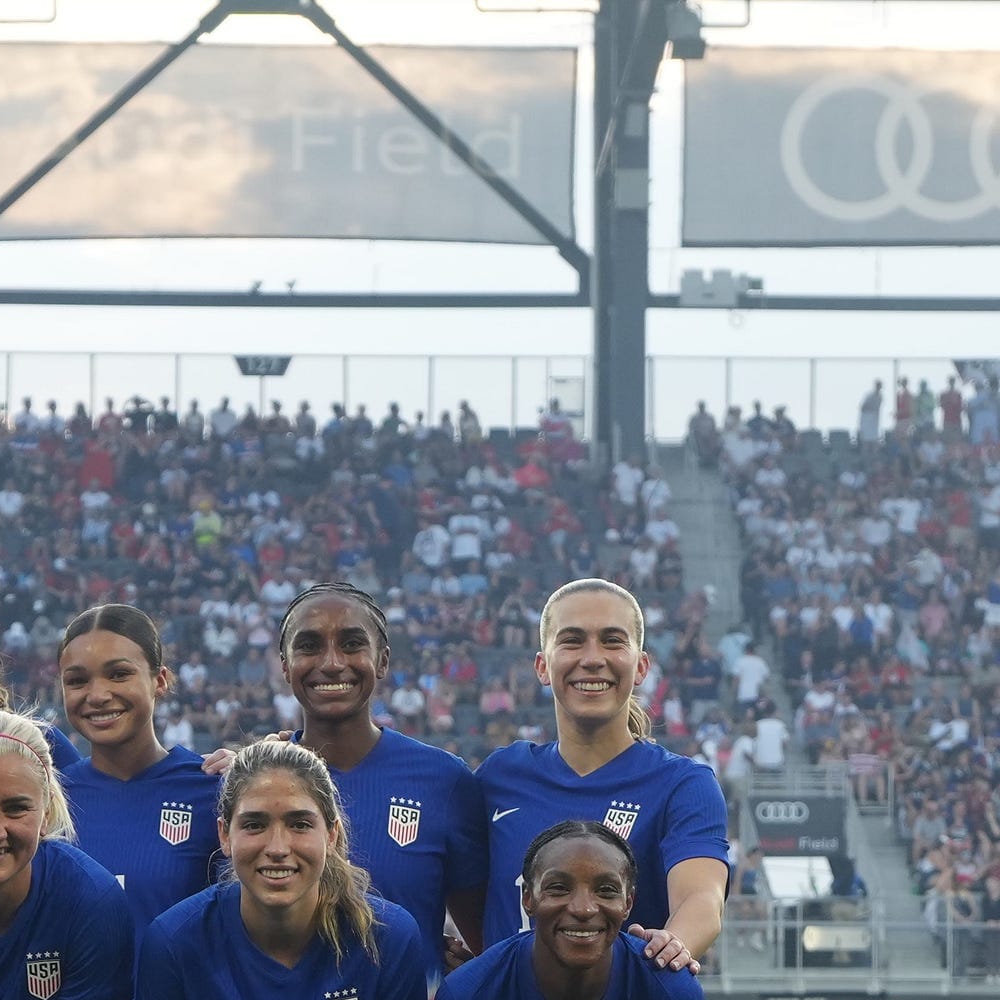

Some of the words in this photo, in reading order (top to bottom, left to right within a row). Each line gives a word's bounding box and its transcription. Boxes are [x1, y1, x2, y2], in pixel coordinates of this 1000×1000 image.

[163, 811, 190, 826] USA
[392, 807, 418, 824] USA
[608, 812, 635, 826] USA
[28, 962, 58, 979] USA
